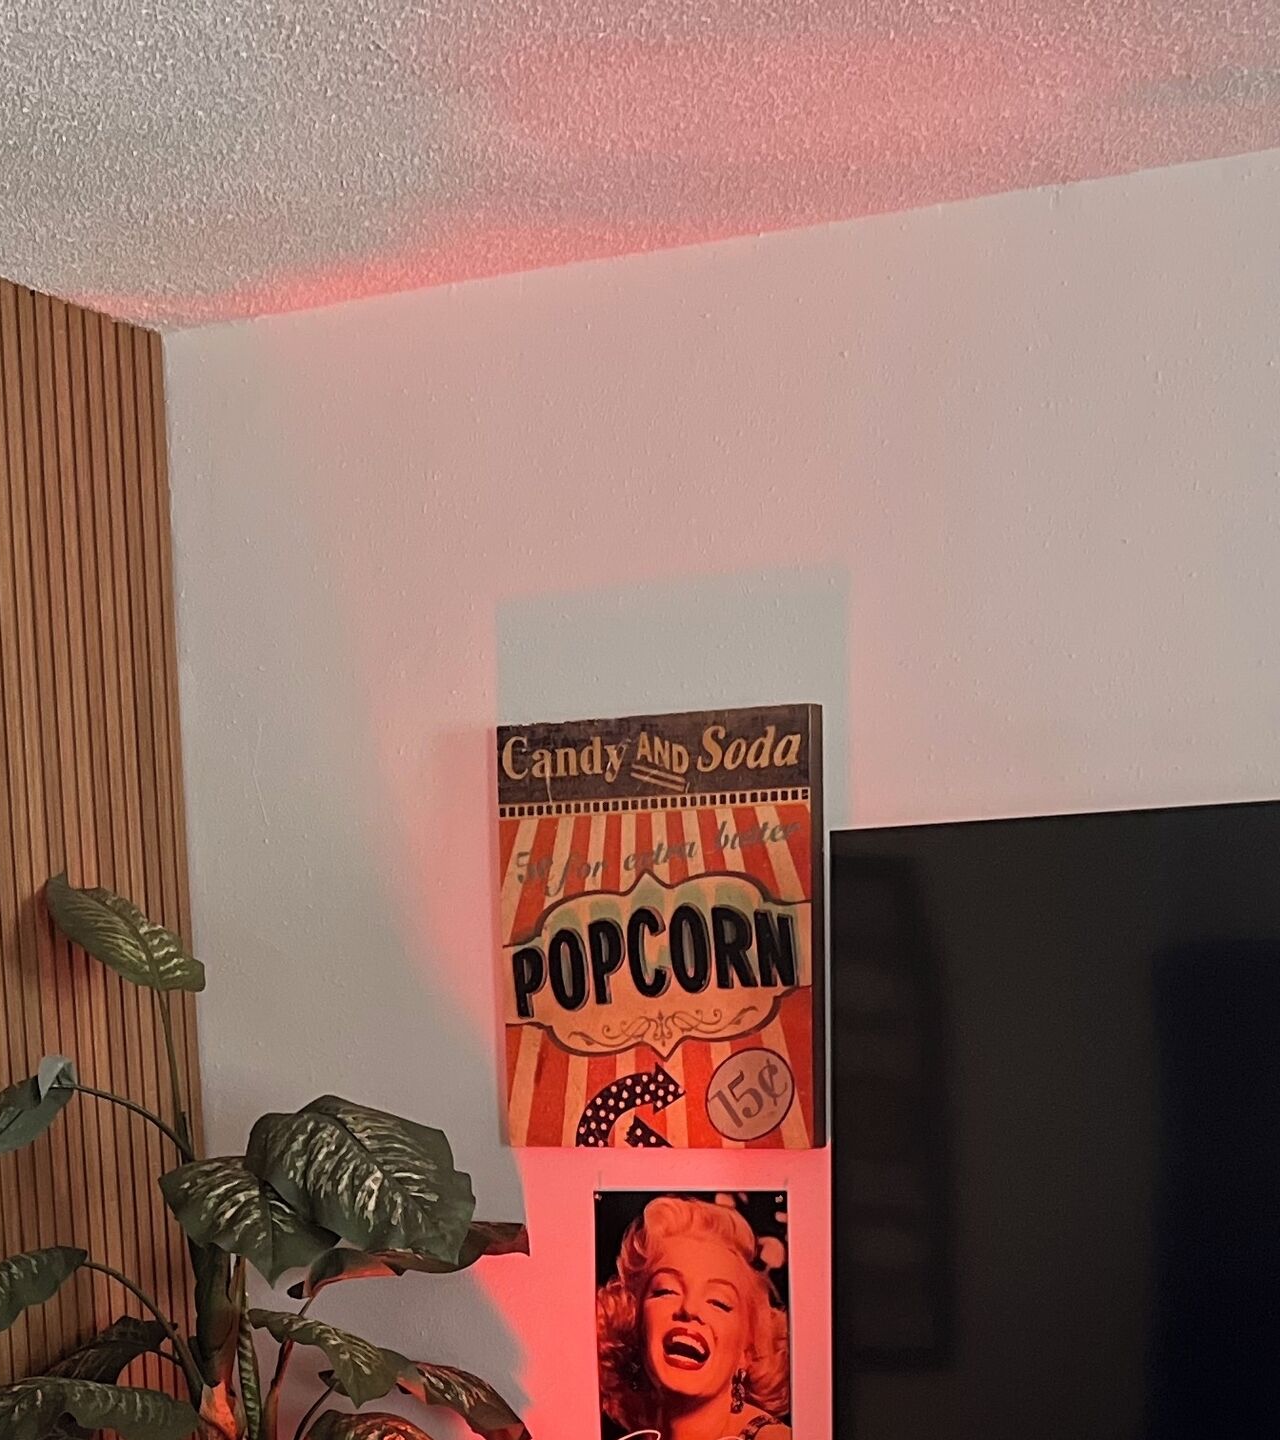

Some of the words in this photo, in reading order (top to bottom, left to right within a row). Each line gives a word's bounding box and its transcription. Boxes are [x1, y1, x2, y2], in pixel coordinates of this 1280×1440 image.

[501, 736, 627, 783] Candy
[636, 731, 690, 775] AND
[697, 725, 802, 773] Soda
[511, 903, 800, 1019] POPCORN
[708, 1058, 789, 1129] 15¢
